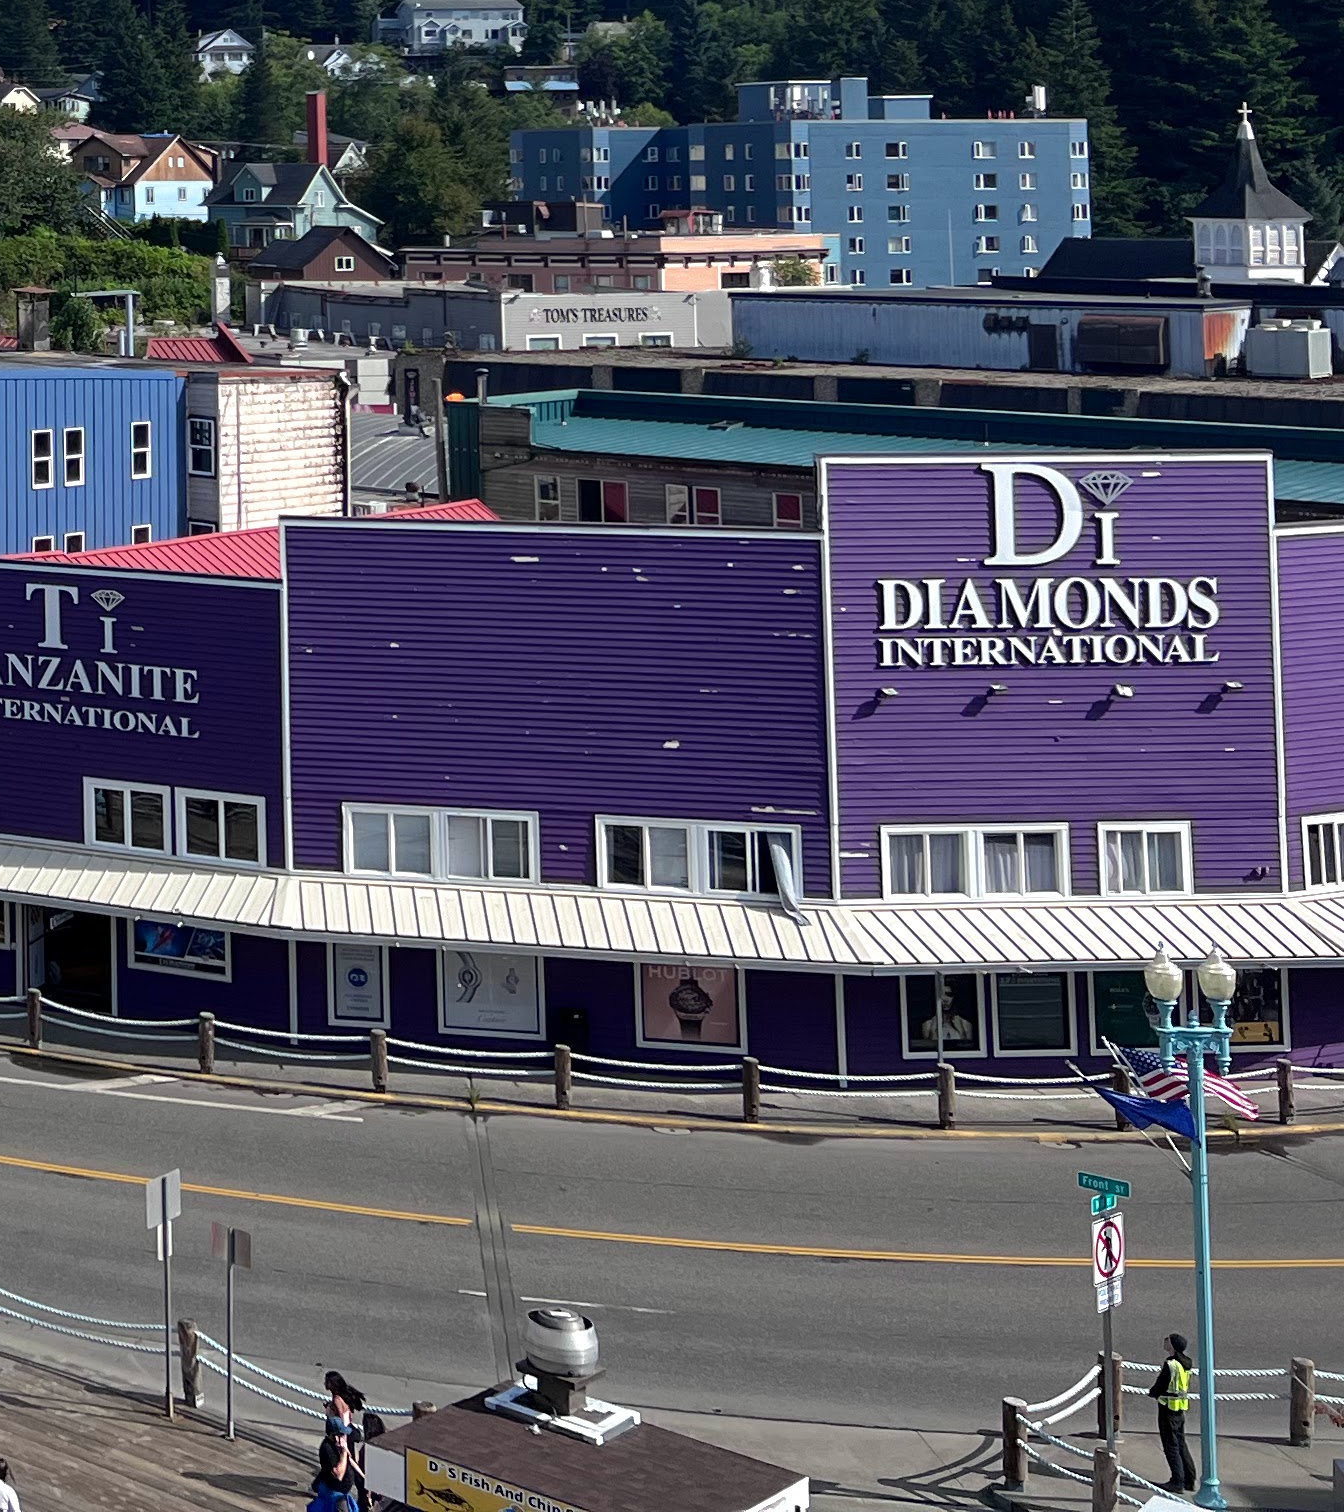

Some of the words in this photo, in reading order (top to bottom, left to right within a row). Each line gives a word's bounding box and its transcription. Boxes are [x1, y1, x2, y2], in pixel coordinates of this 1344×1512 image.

[543, 308, 579, 323] TOM'S
[581, 307, 649, 322] TREASURES
[876, 577, 1220, 630] DIAMONDS
[878, 633, 1220, 667] INTERNATIONAL
[648, 965, 728, 982] HUBLOT
[1082, 1175, 1109, 1191] Front
[461, 1471, 490, 1492] Fish
[494, 1485, 523, 1504] And
